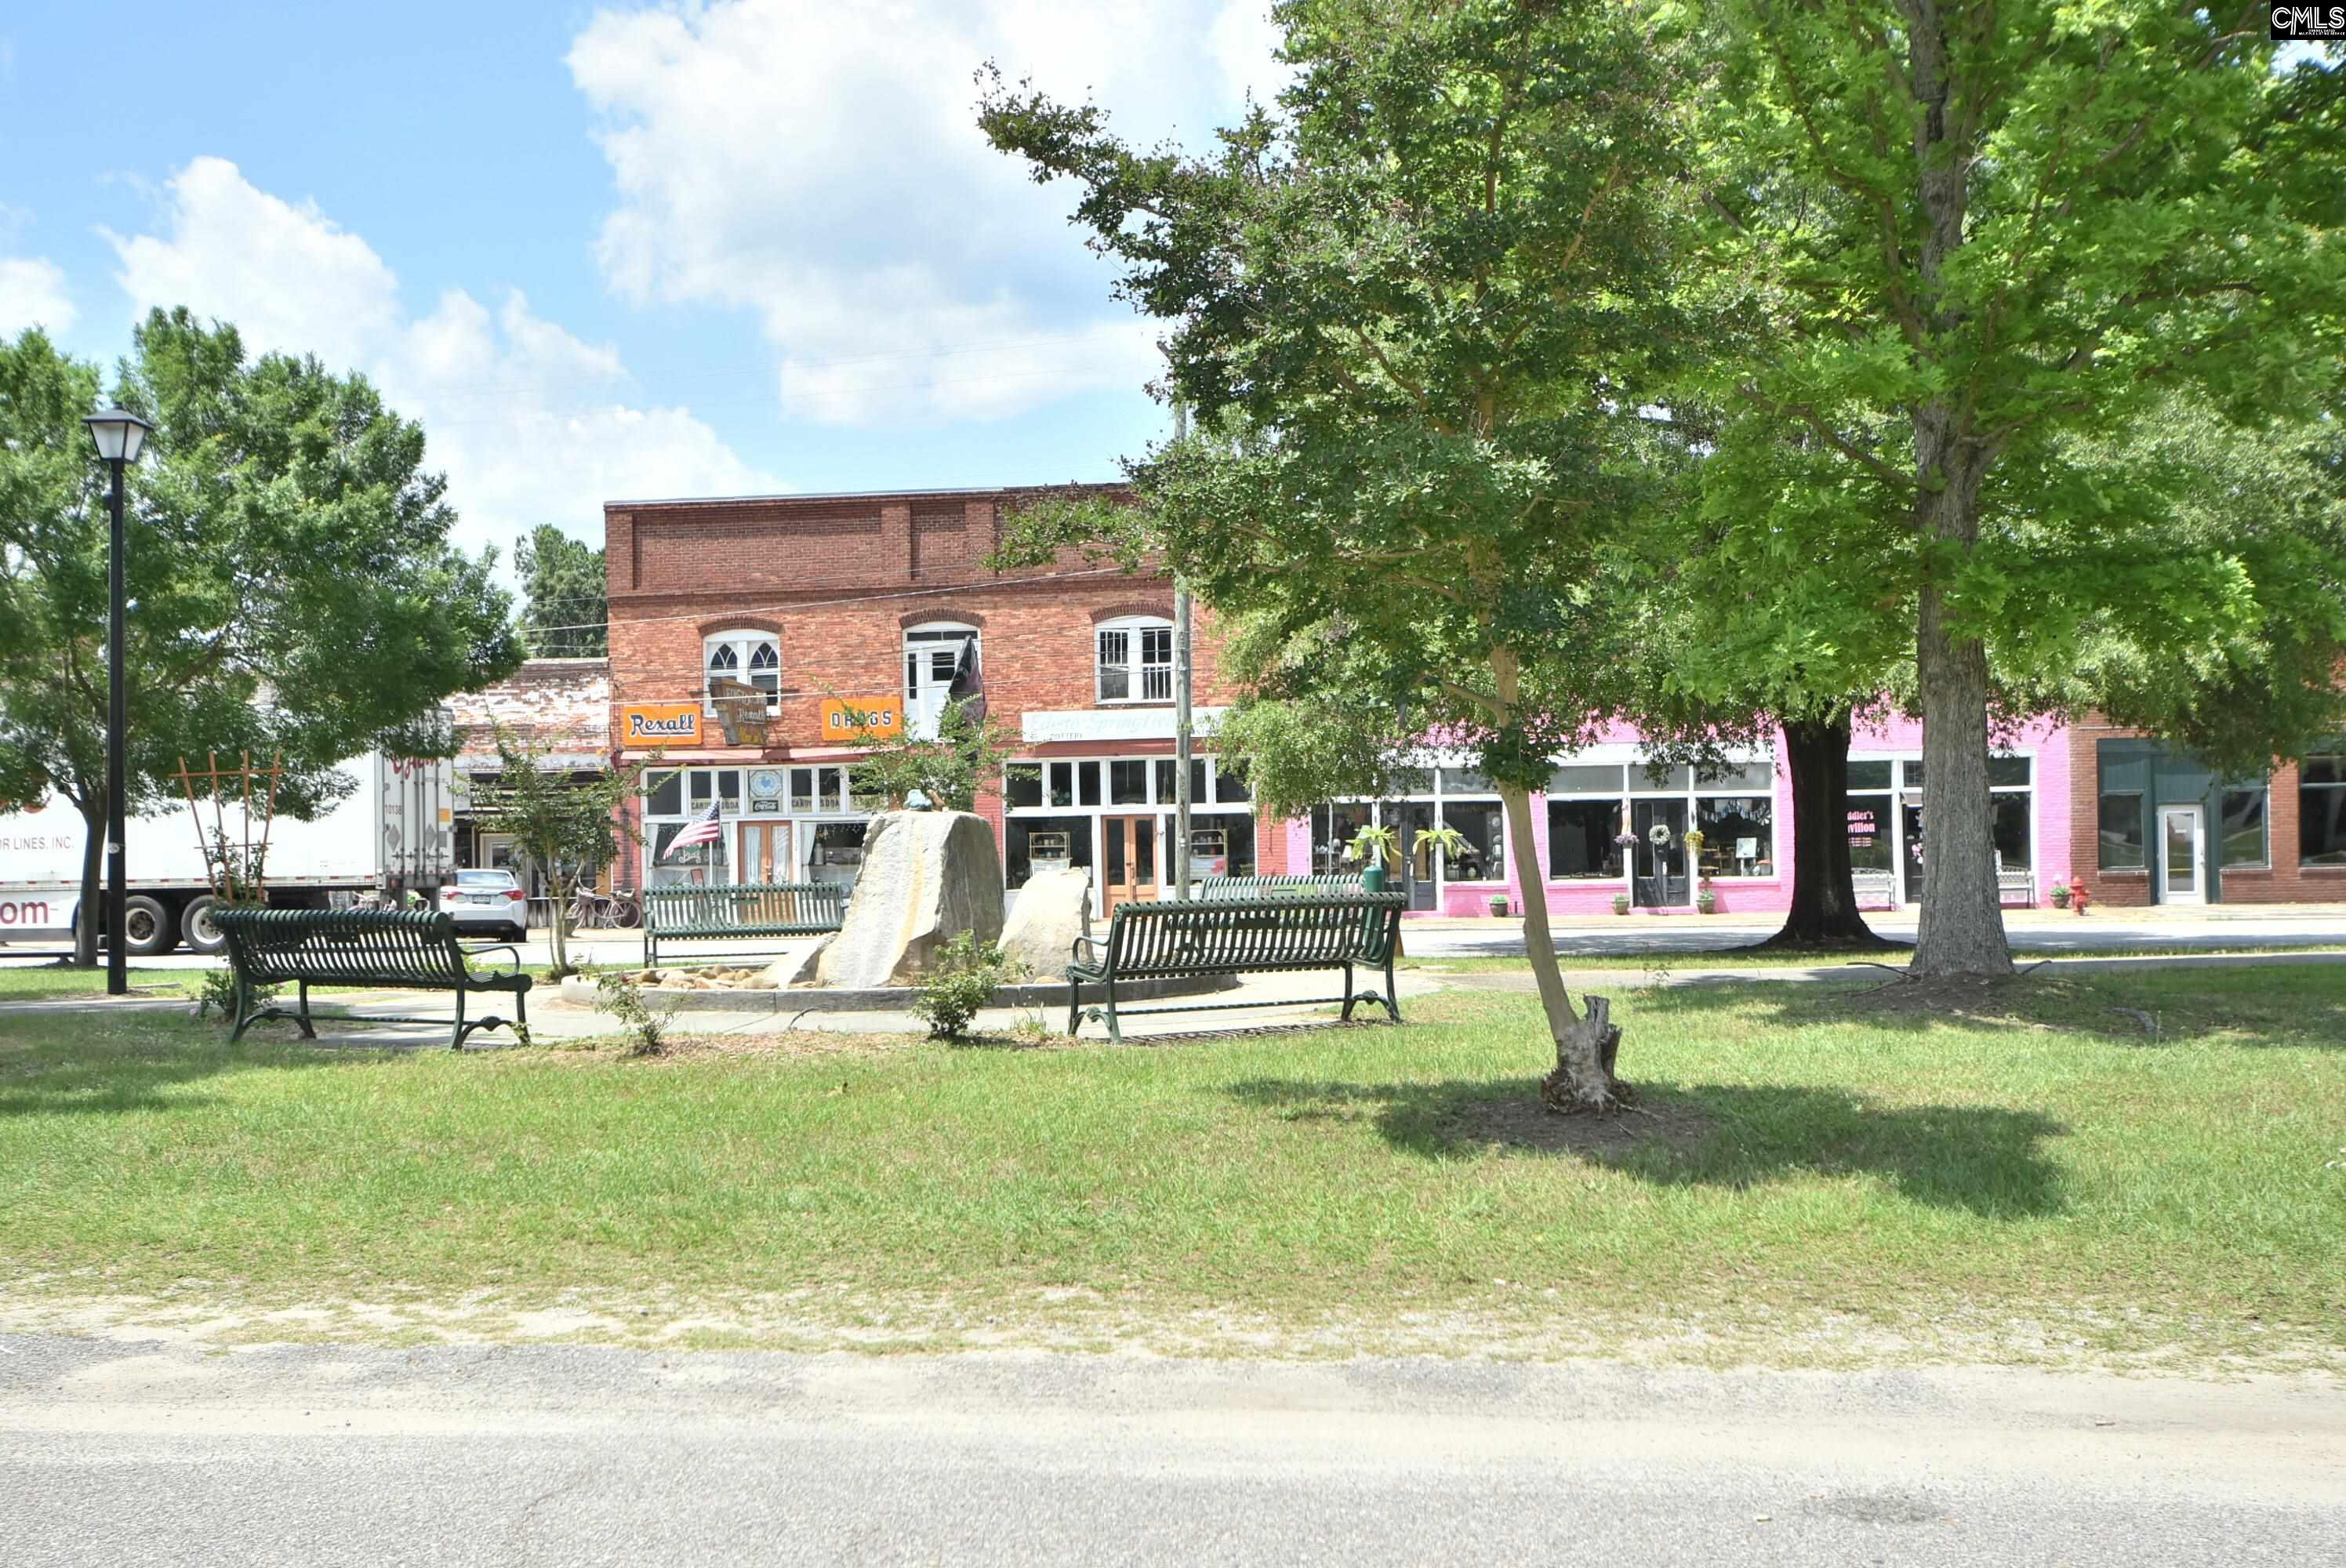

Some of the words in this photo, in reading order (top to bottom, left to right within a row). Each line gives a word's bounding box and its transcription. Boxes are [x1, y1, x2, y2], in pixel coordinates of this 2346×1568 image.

[628, 713, 695, 736] Rexall
[13, 837, 48, 851] LINES,
[52, 836, 74, 849] INC.
